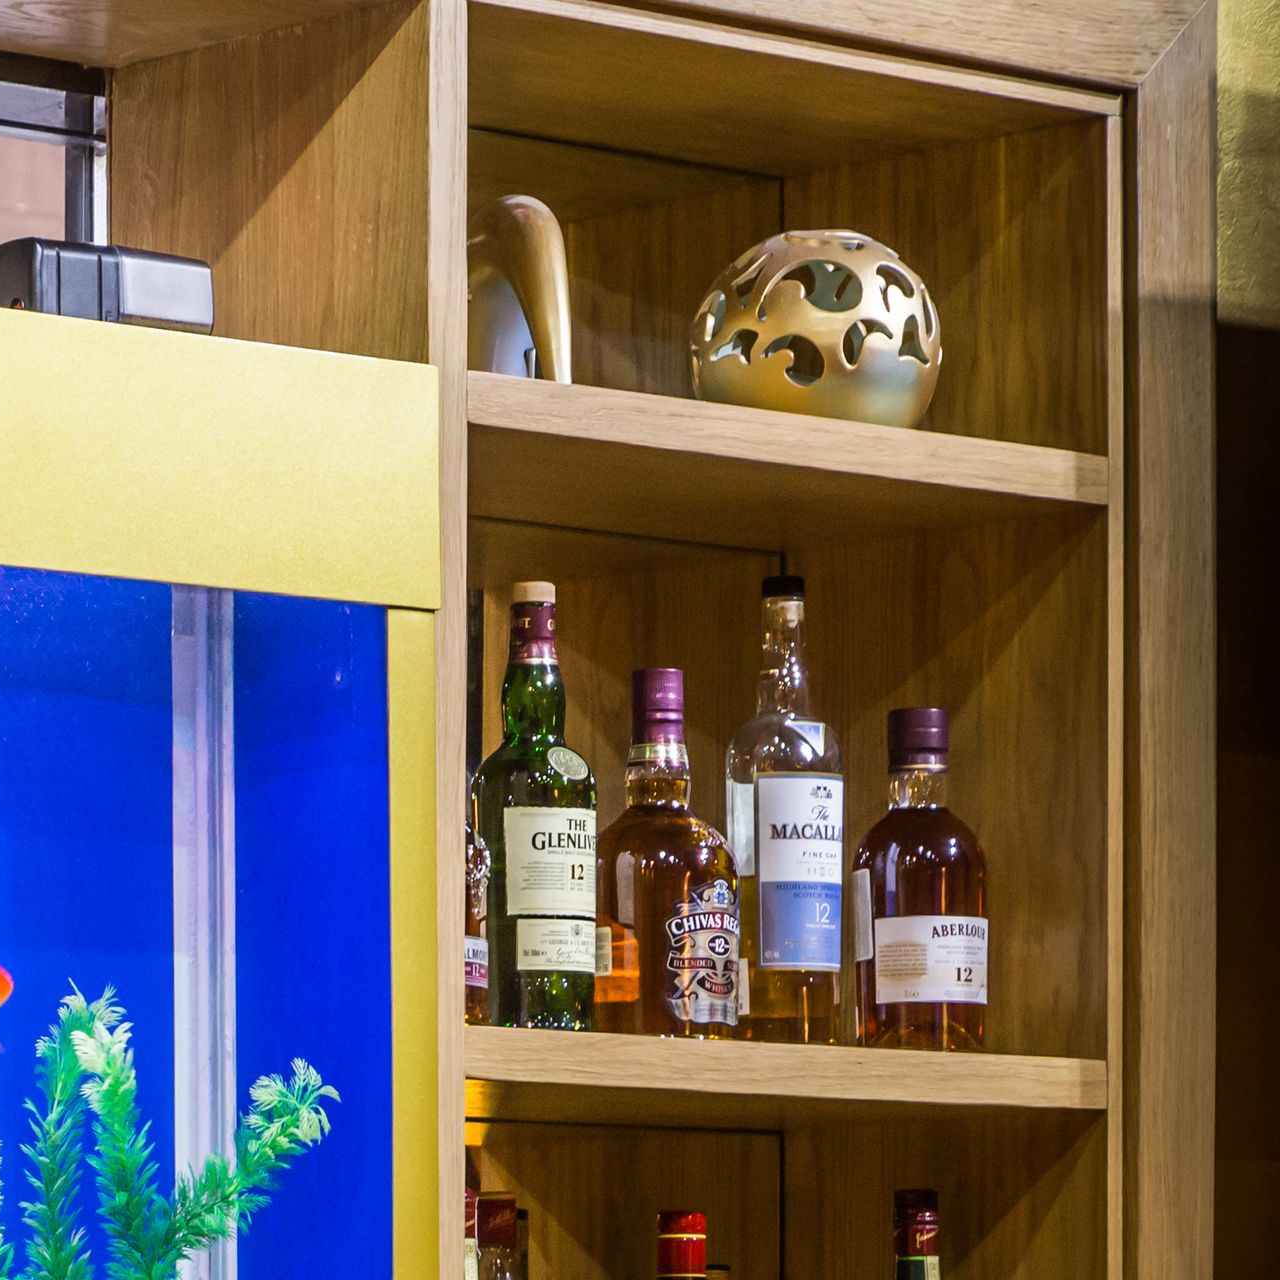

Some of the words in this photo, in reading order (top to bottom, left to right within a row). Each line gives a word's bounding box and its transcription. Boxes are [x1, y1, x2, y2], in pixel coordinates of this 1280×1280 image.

[811, 804, 829, 820] The
[567, 819, 587, 831] THE
[571, 863, 584, 880] 12
[776, 883, 818, 891] HIGHLAND
[815, 902, 831, 923] 12
[671, 914, 721, 936] CHIVAS
[715, 938, 725, 953] 12
[472, 963, 480, 977] 12
[674, 959, 713, 968] BLENDED
[956, 967, 973, 983] 12
